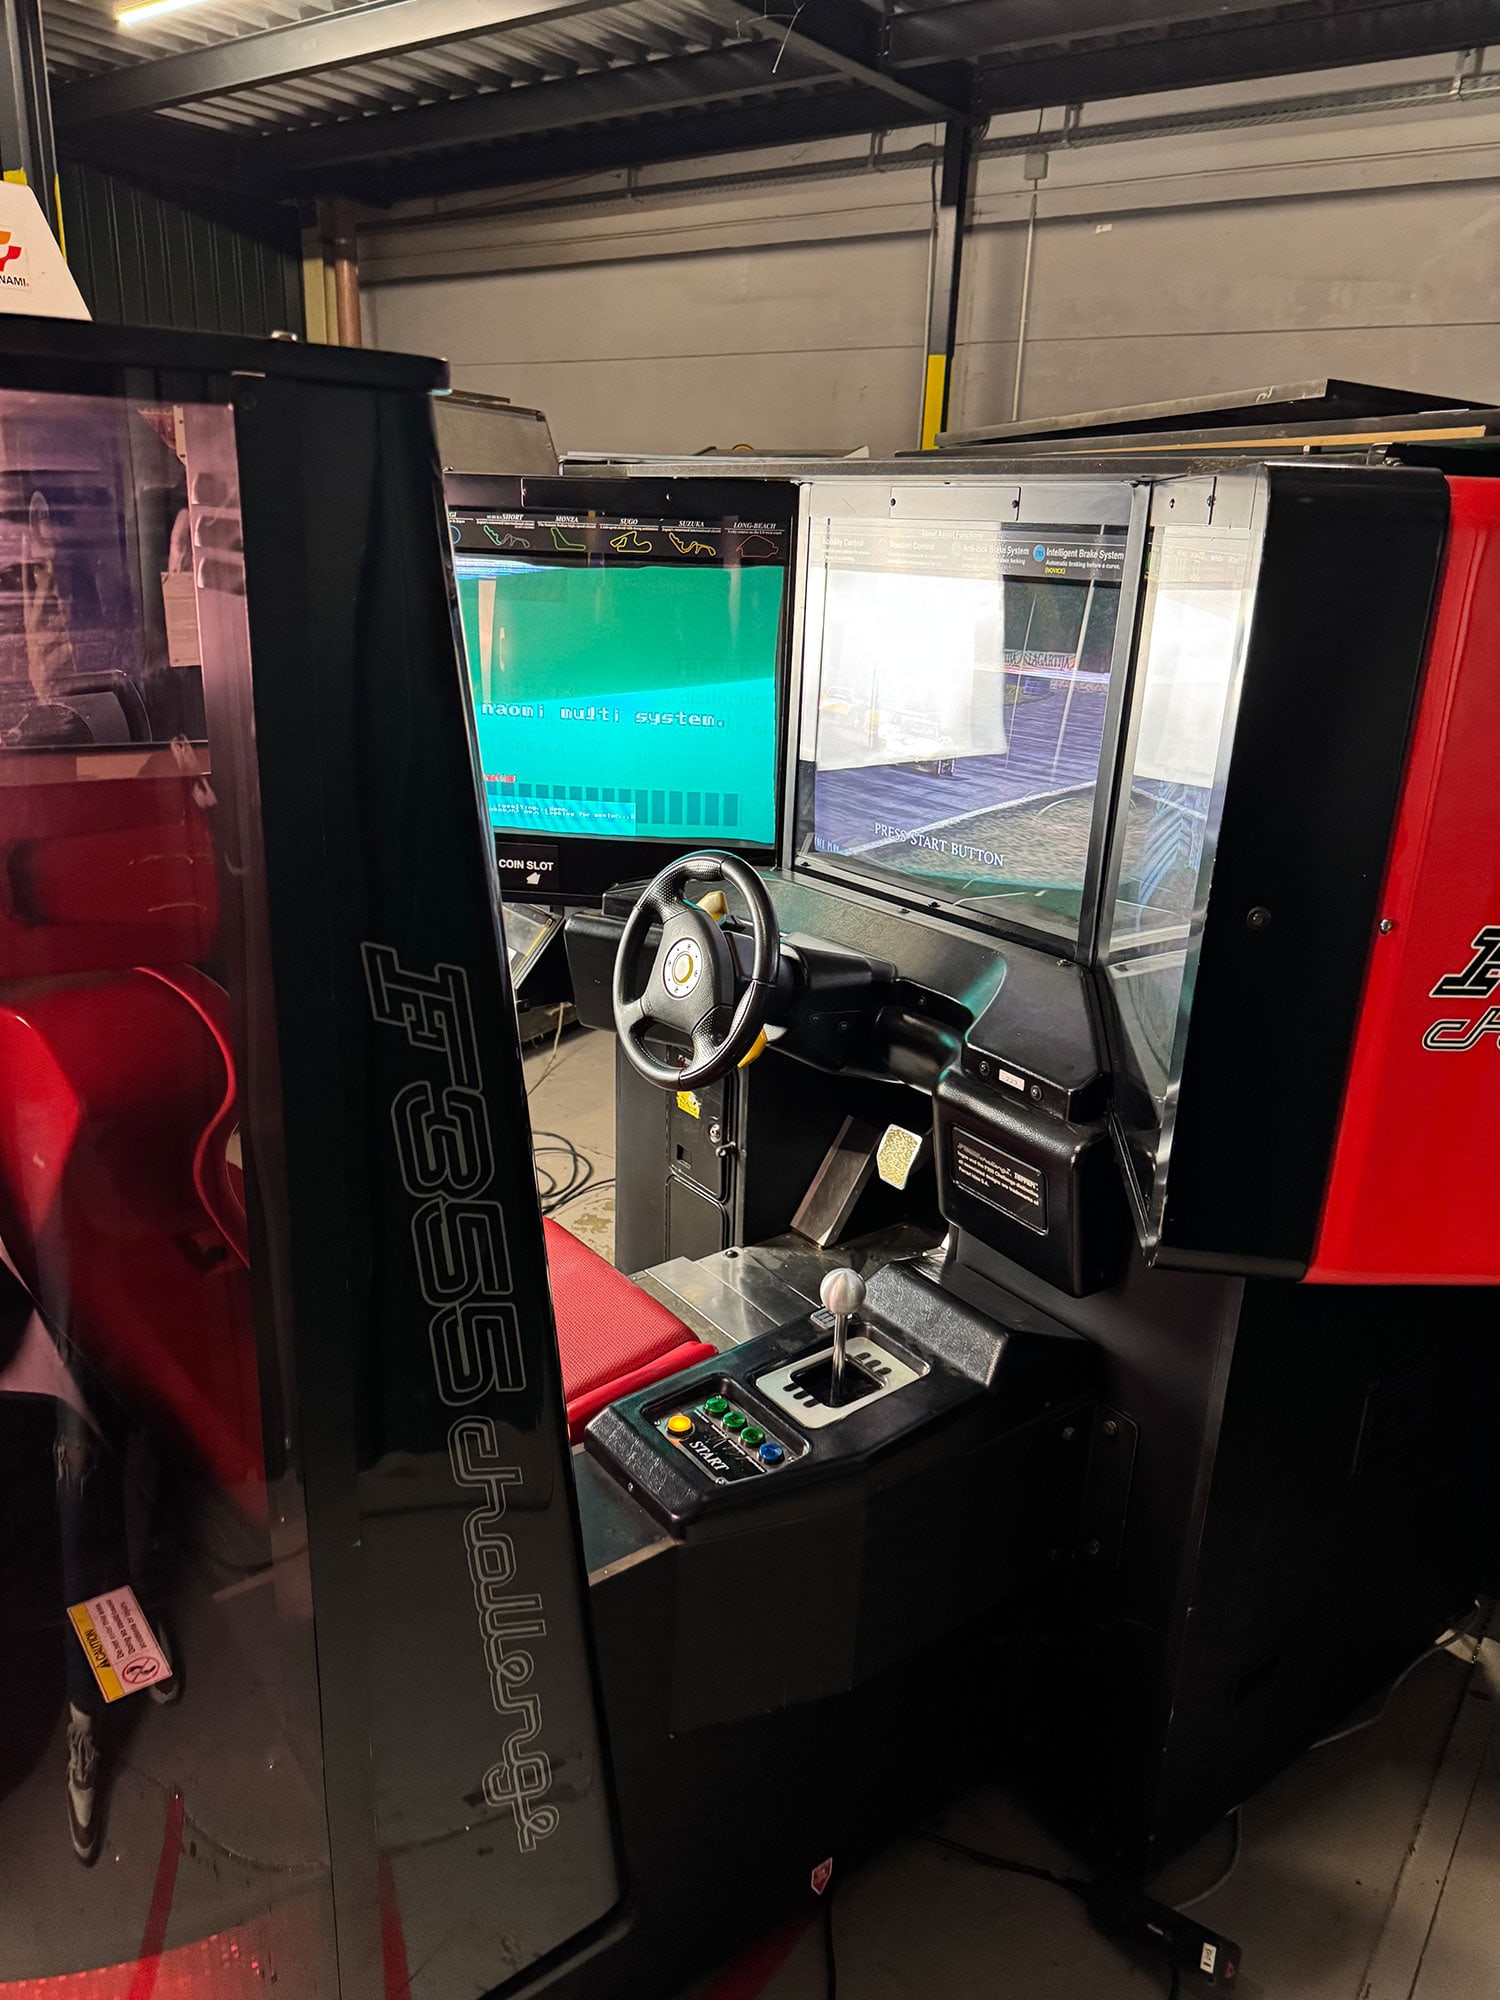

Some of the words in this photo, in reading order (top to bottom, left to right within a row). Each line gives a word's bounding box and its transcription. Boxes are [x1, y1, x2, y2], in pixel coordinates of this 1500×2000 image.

[1007, 545, 1029, 556] System
[1046, 547, 1078, 559] Intelligent
[1079, 549, 1098, 559] Brake
[1099, 550, 1125, 560] System
[1045, 559, 1068, 567] Automatic
[481, 702, 544, 718] naomi
[560, 705, 620, 722] multi
[635, 710, 725, 728] system.
[874, 822, 906, 842] PRESS
[910, 832, 947, 851] START
[951, 842, 1004, 867] BUTTON
[499, 859, 524, 869] COIN
[526, 861, 554, 871] SLOT
[360, 941, 527, 1407] F355
[690, 1440, 730, 1471] START
[85, 1629, 106, 1661] CAUTION
[111, 1639, 121, 1650] not
[124, 1636, 136, 1653] Doing
